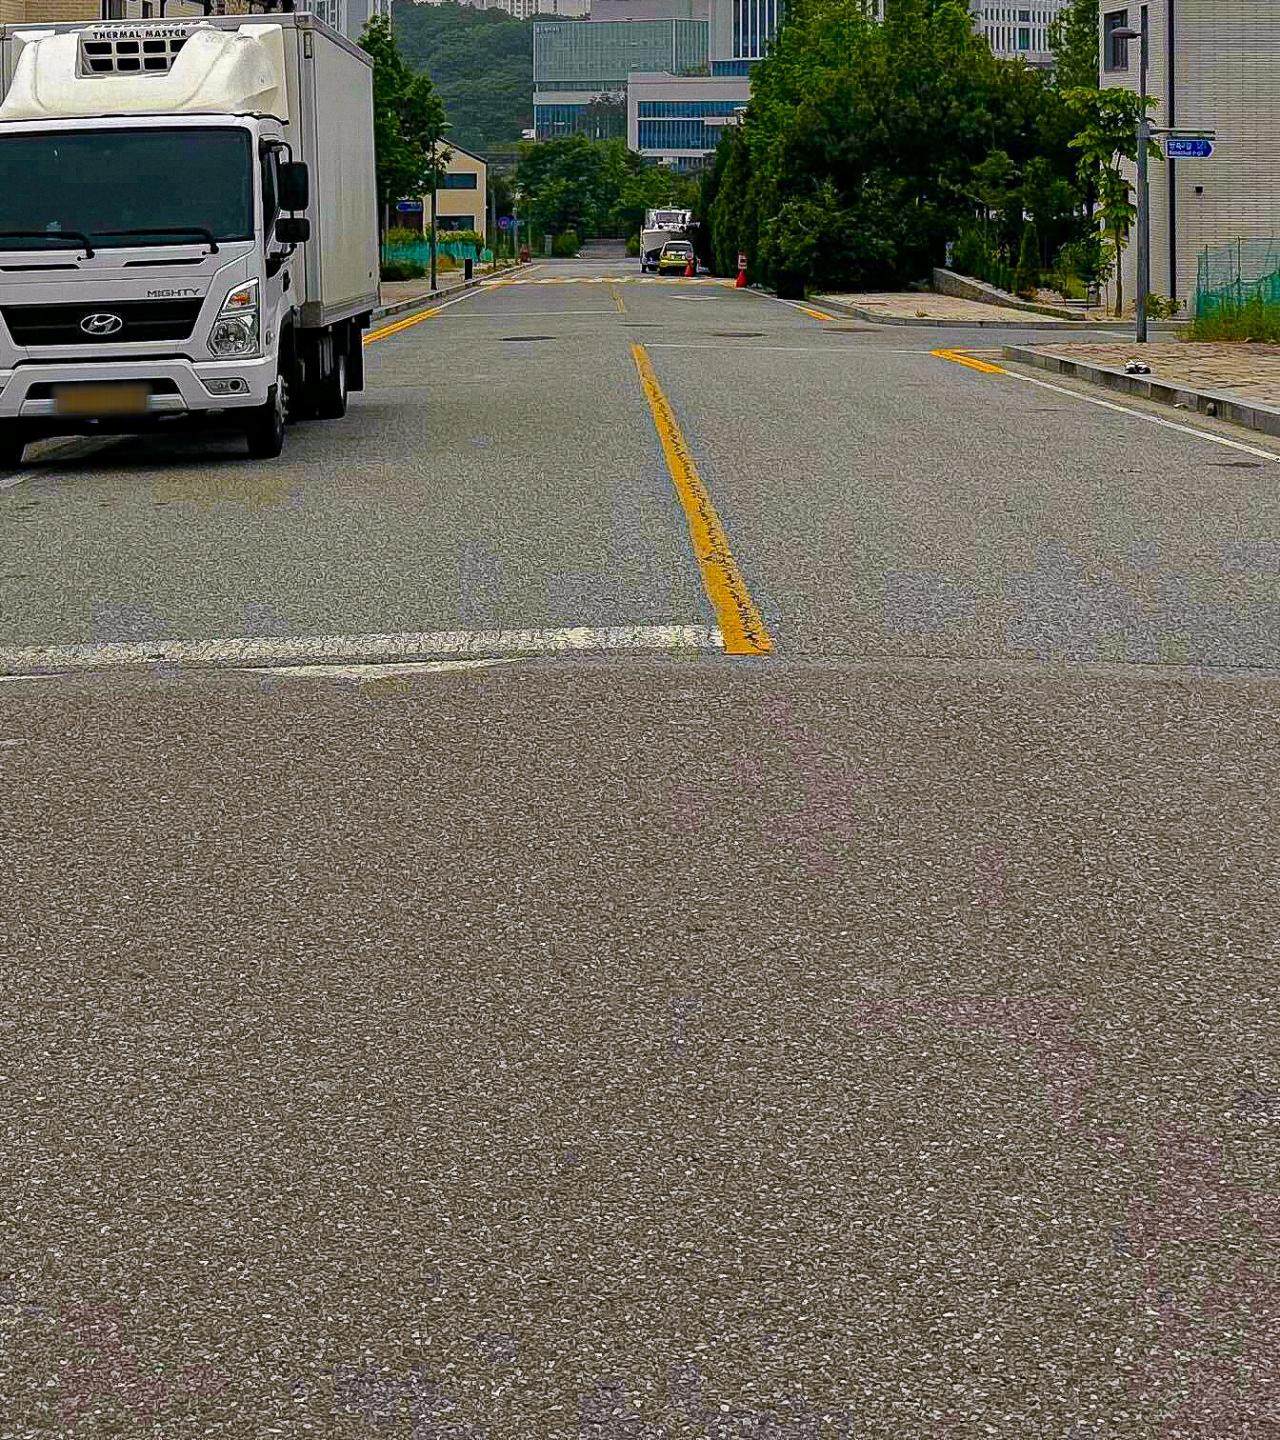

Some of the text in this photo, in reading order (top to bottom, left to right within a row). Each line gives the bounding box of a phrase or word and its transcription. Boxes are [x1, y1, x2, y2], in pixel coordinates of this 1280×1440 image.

[92, 29, 187, 40] THERMAL MASTER
[147, 288, 200, 298] MIGHTY
